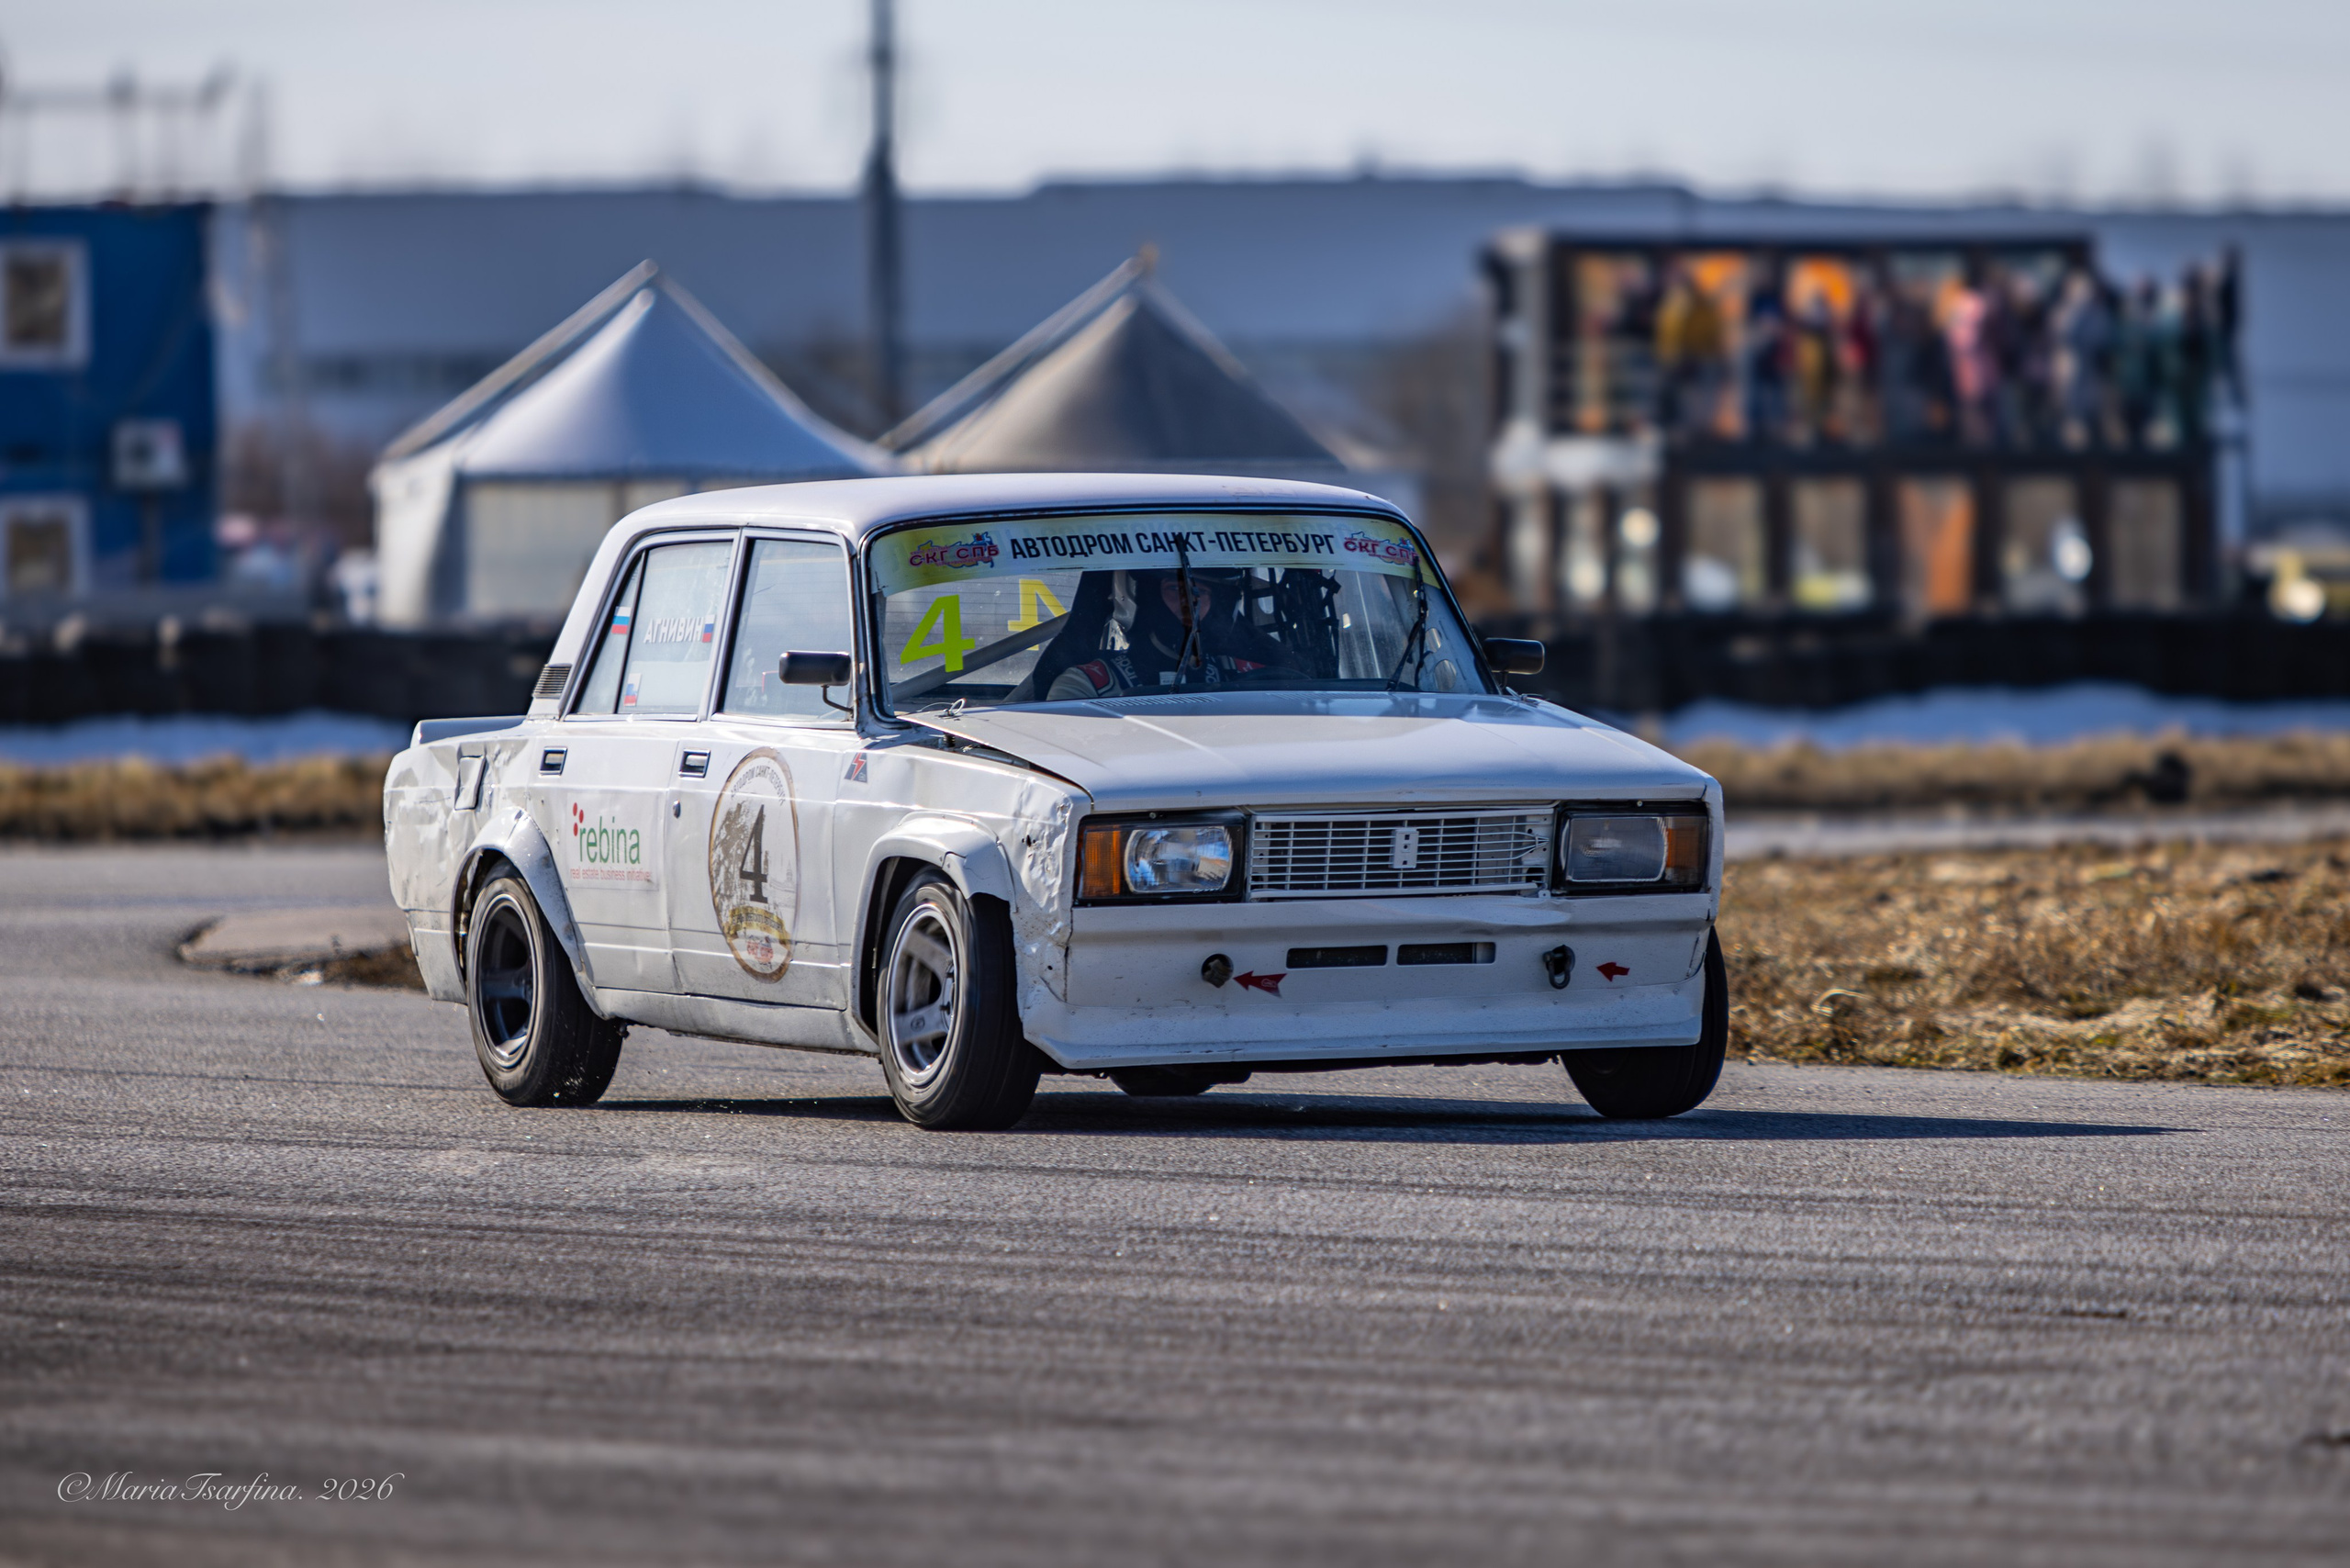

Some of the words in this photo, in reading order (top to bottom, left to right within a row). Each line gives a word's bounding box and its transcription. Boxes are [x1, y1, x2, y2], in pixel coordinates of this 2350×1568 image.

[909, 550, 947, 566] СКГ
[956, 543, 1000, 559] СПБ
[1010, 532, 1133, 559] АВТОДРОМ
[1136, 531, 1335, 554] САНКТ-ПЕТЕРБУРГ
[1344, 540, 1379, 554] СКГ
[643, 616, 705, 644] АГНИВИН
[900, 594, 975, 672] 4
[579, 815, 641, 864] rebina
[739, 803, 768, 904] 4
